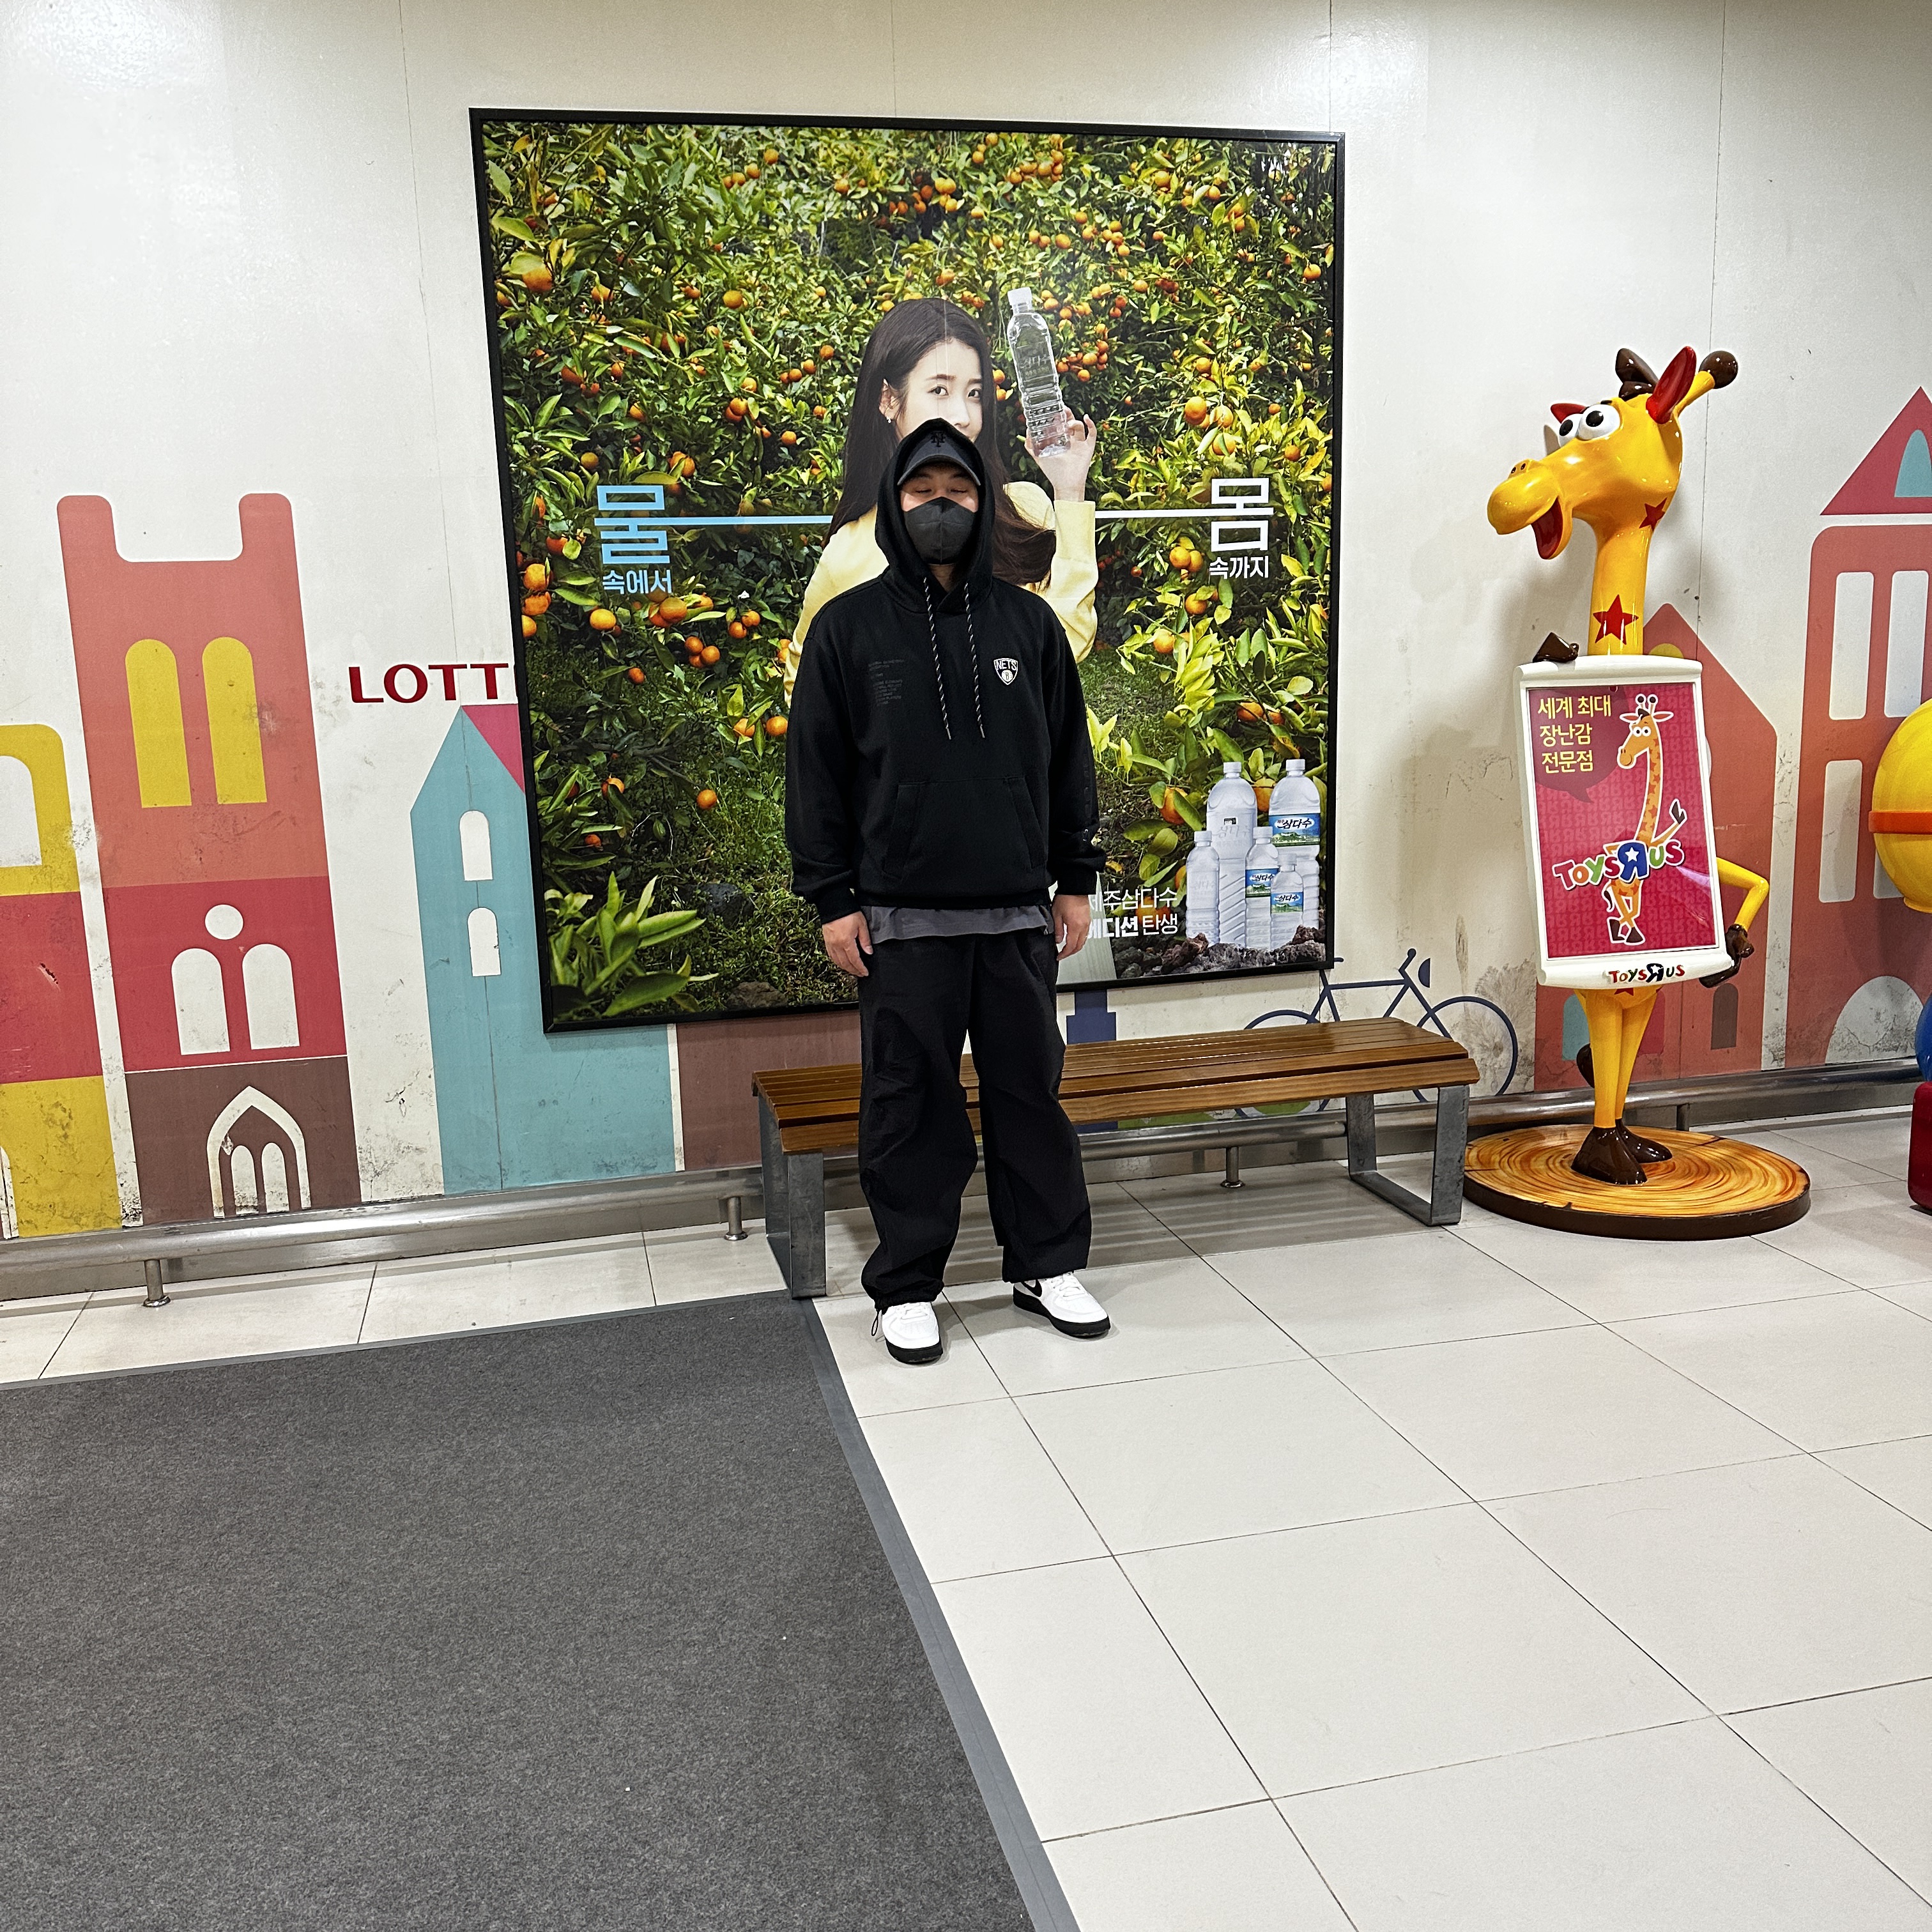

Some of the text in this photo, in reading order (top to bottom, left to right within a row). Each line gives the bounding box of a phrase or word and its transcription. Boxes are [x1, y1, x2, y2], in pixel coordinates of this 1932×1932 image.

[594, 485, 670, 564] 물
[1206, 478, 1274, 552] 몸
[1209, 555, 1269, 579] 속까지
[602, 569, 671, 594] 속에서
[995, 659, 1017, 671] NETS
[349, 663, 518, 703] LOTT
[1538, 694, 1611, 719] 세계 최대
[1540, 723, 1593, 747] 장난감
[1542, 749, 1593, 774] 전문점
[1277, 818, 1312, 829] 삼다수
[1142, 913, 1178, 935] 탄생
